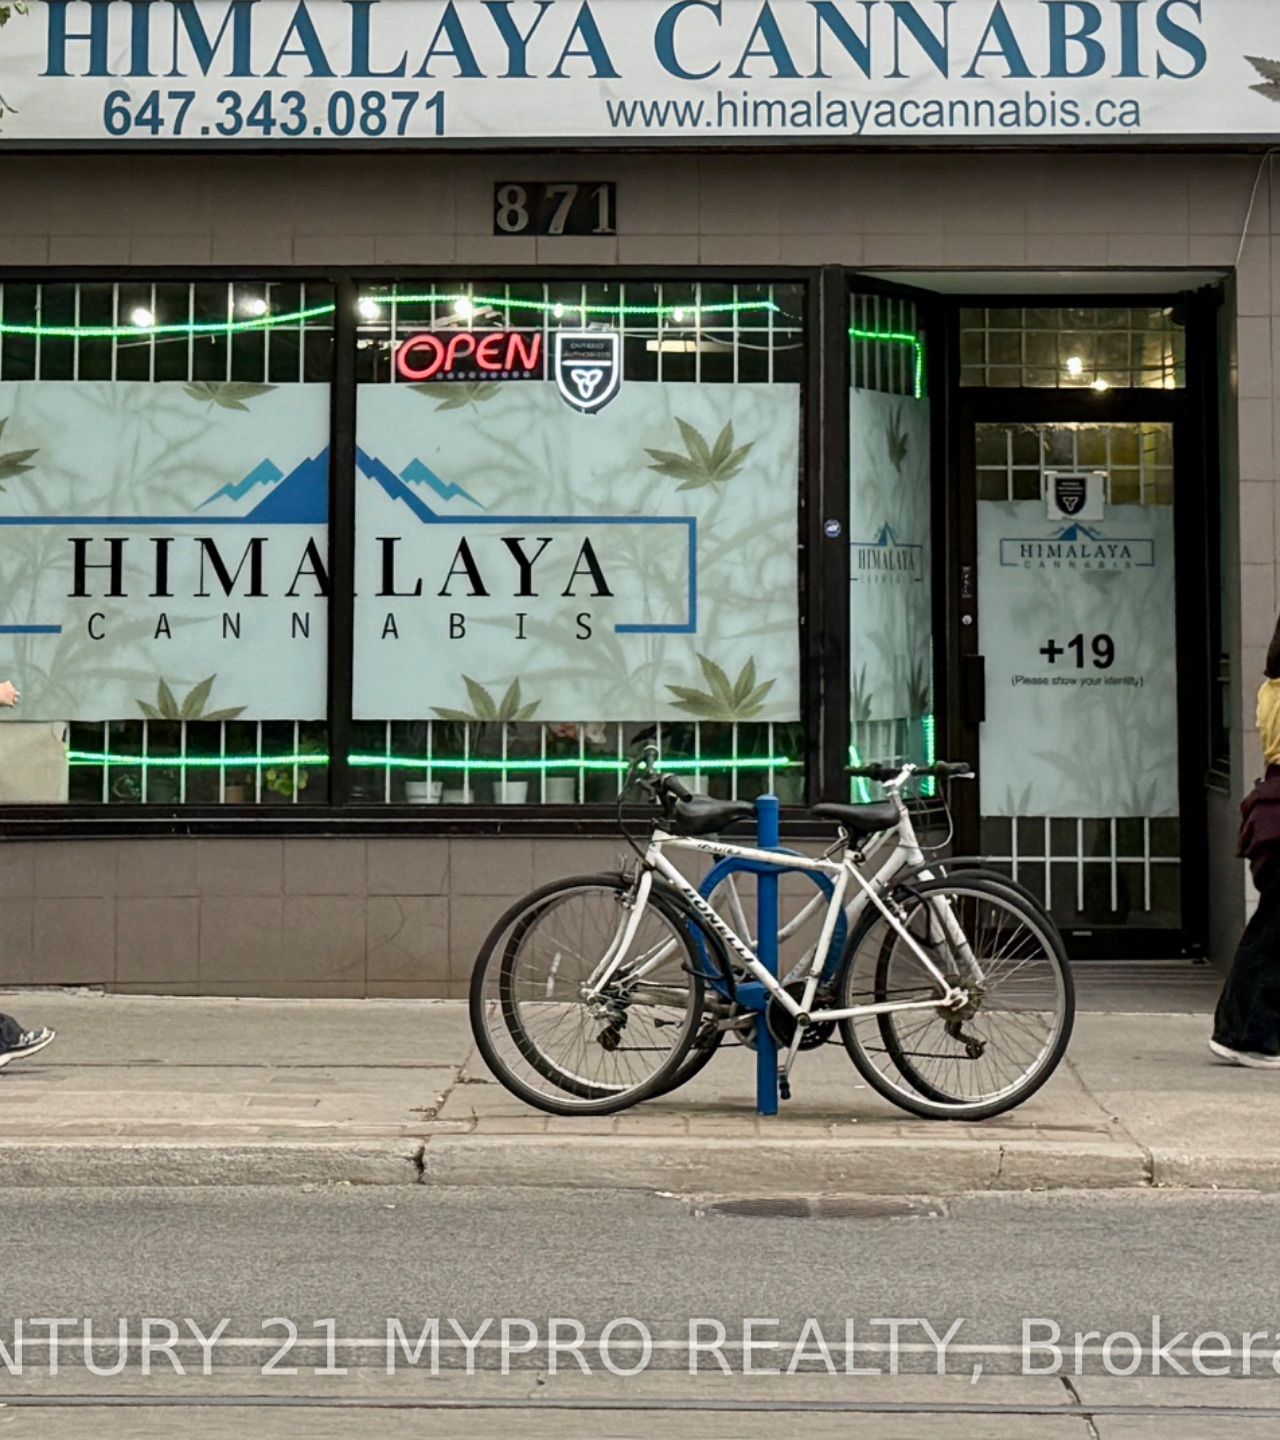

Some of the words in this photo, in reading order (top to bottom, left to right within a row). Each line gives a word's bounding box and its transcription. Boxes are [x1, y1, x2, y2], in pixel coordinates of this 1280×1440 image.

[104, 90, 445, 137] 647.343.0871
[605, 90, 1141, 136] www.himalayacannabis.ca
[496, 184, 616, 235] 871
[396, 332, 542, 380] OPEN
[67, 536, 613, 598] HIMALAYA
[1020, 543, 1132, 559] HIMALAYA
[87, 612, 594, 641] CANNABIS
[1039, 633, 1116, 670] +19
